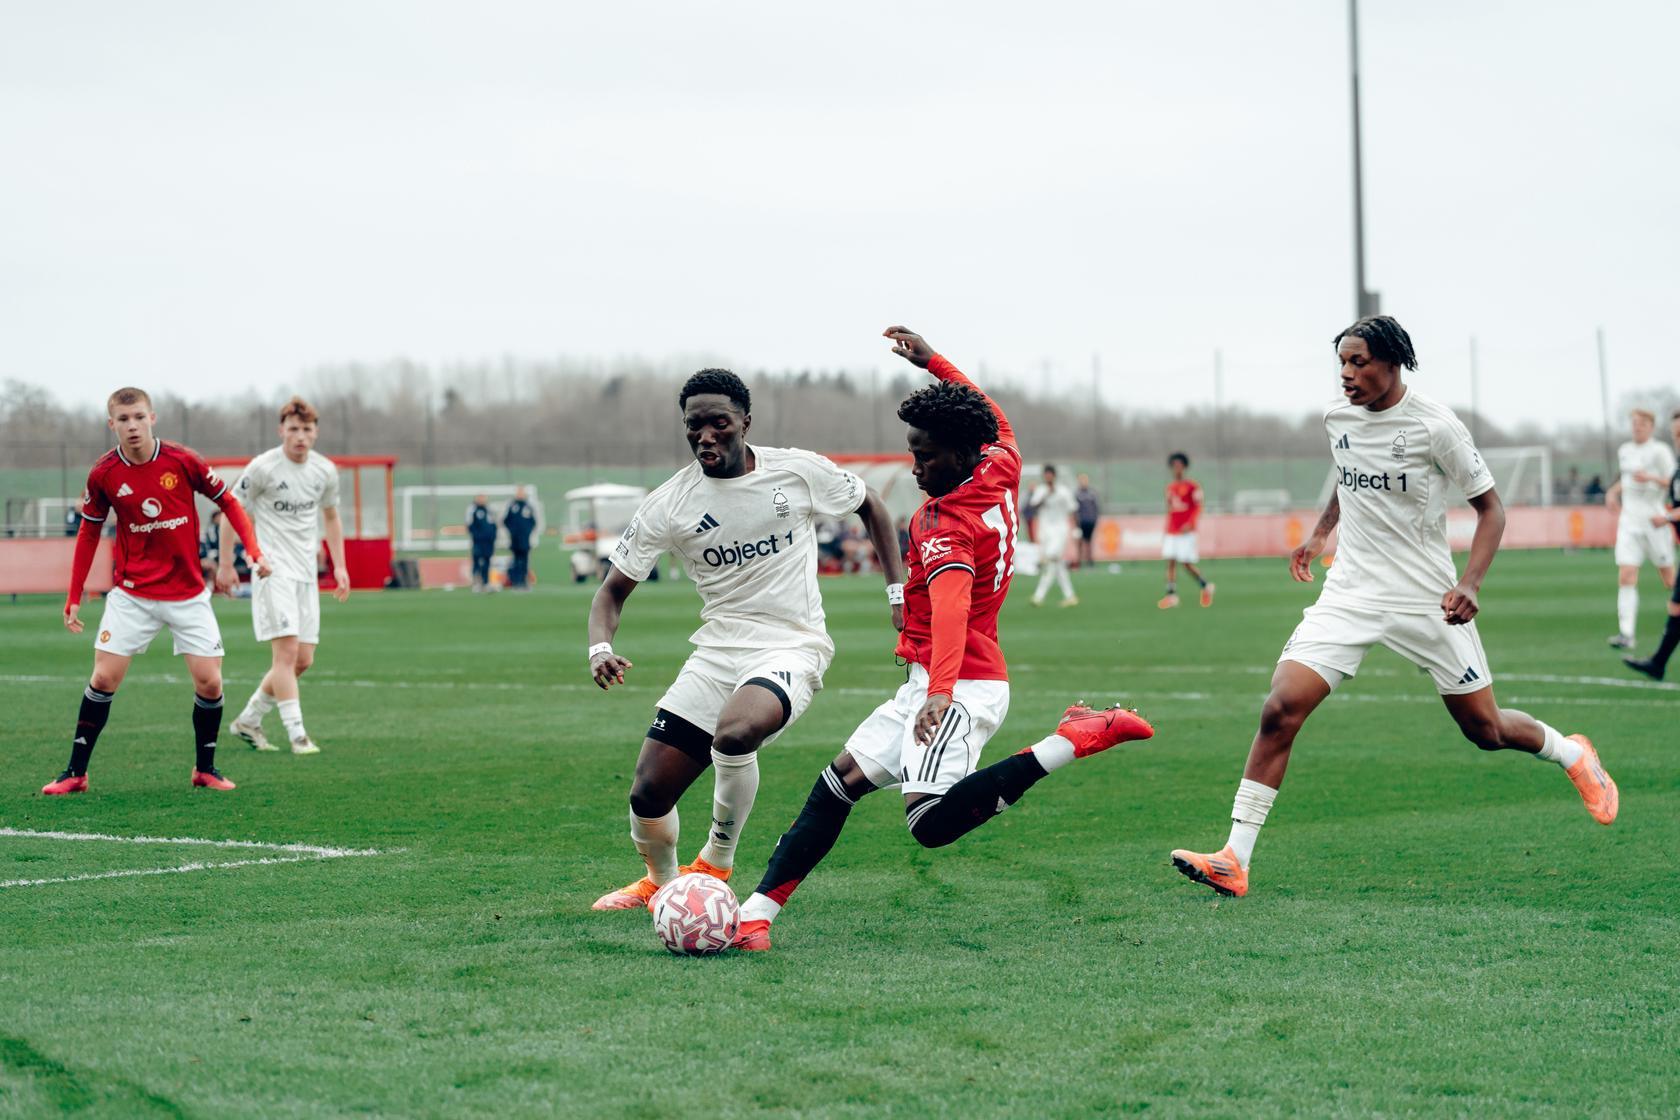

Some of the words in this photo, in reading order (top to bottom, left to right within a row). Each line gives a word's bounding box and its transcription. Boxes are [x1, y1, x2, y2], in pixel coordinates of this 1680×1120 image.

[1397, 473, 1407, 492] 1
[129, 516, 188, 533] Snapdragon
[702, 535, 780, 567] Object
[785, 530, 793, 545] 1
